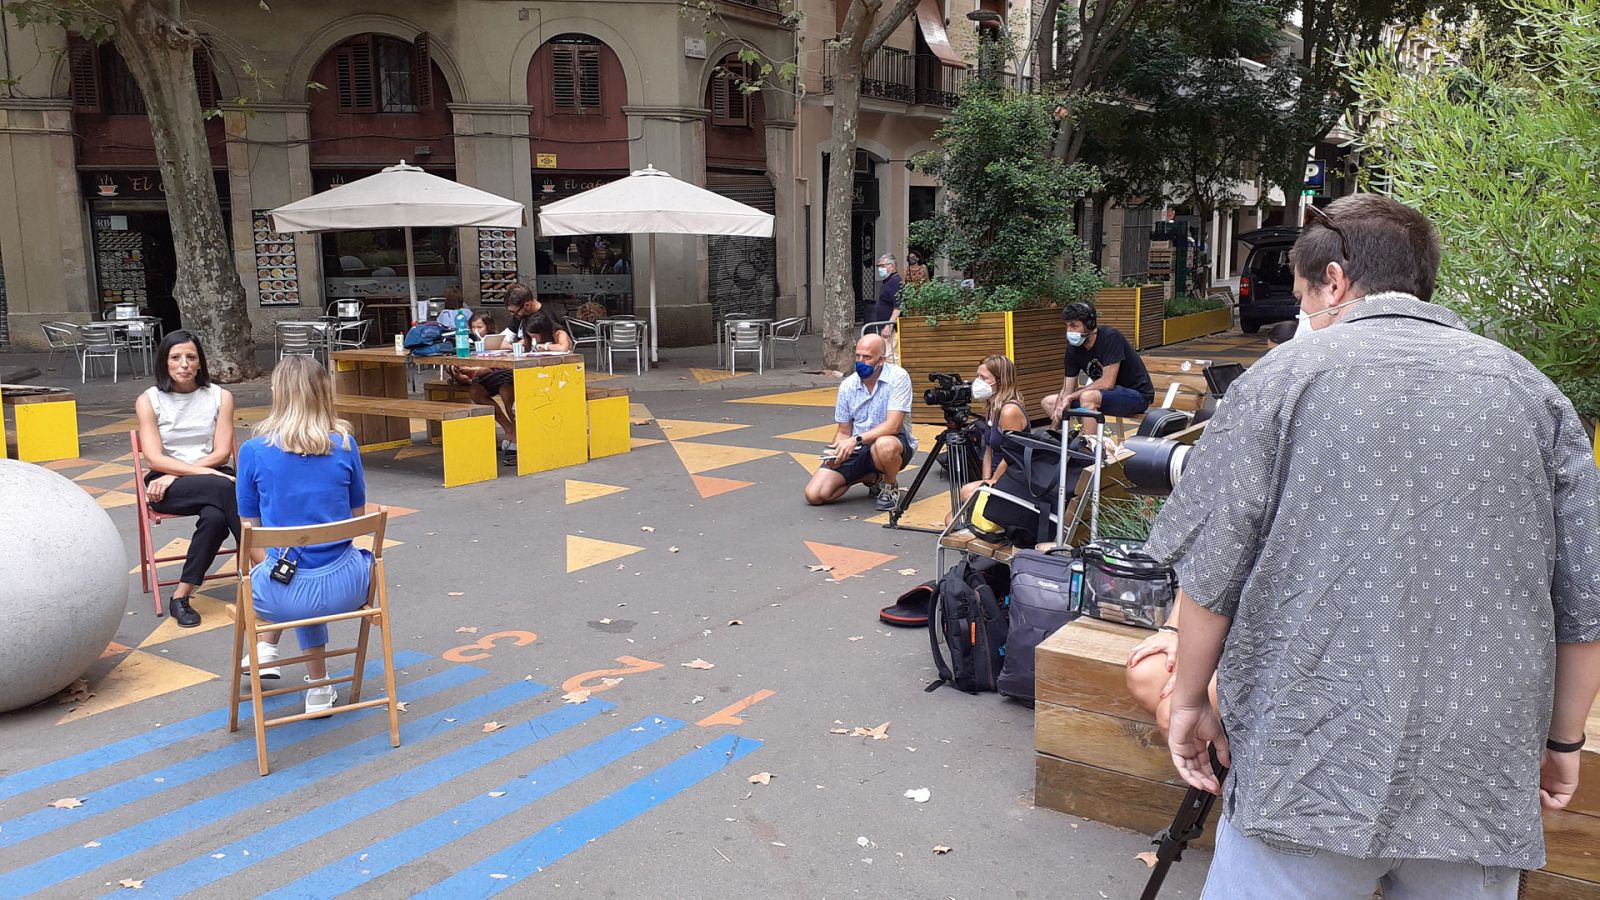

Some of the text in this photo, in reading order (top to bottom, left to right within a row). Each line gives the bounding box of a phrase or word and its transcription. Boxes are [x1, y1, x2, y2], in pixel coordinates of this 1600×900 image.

[1304, 164, 1318, 182] P
[131, 176, 153, 191] El
[564, 178, 577, 190] El
